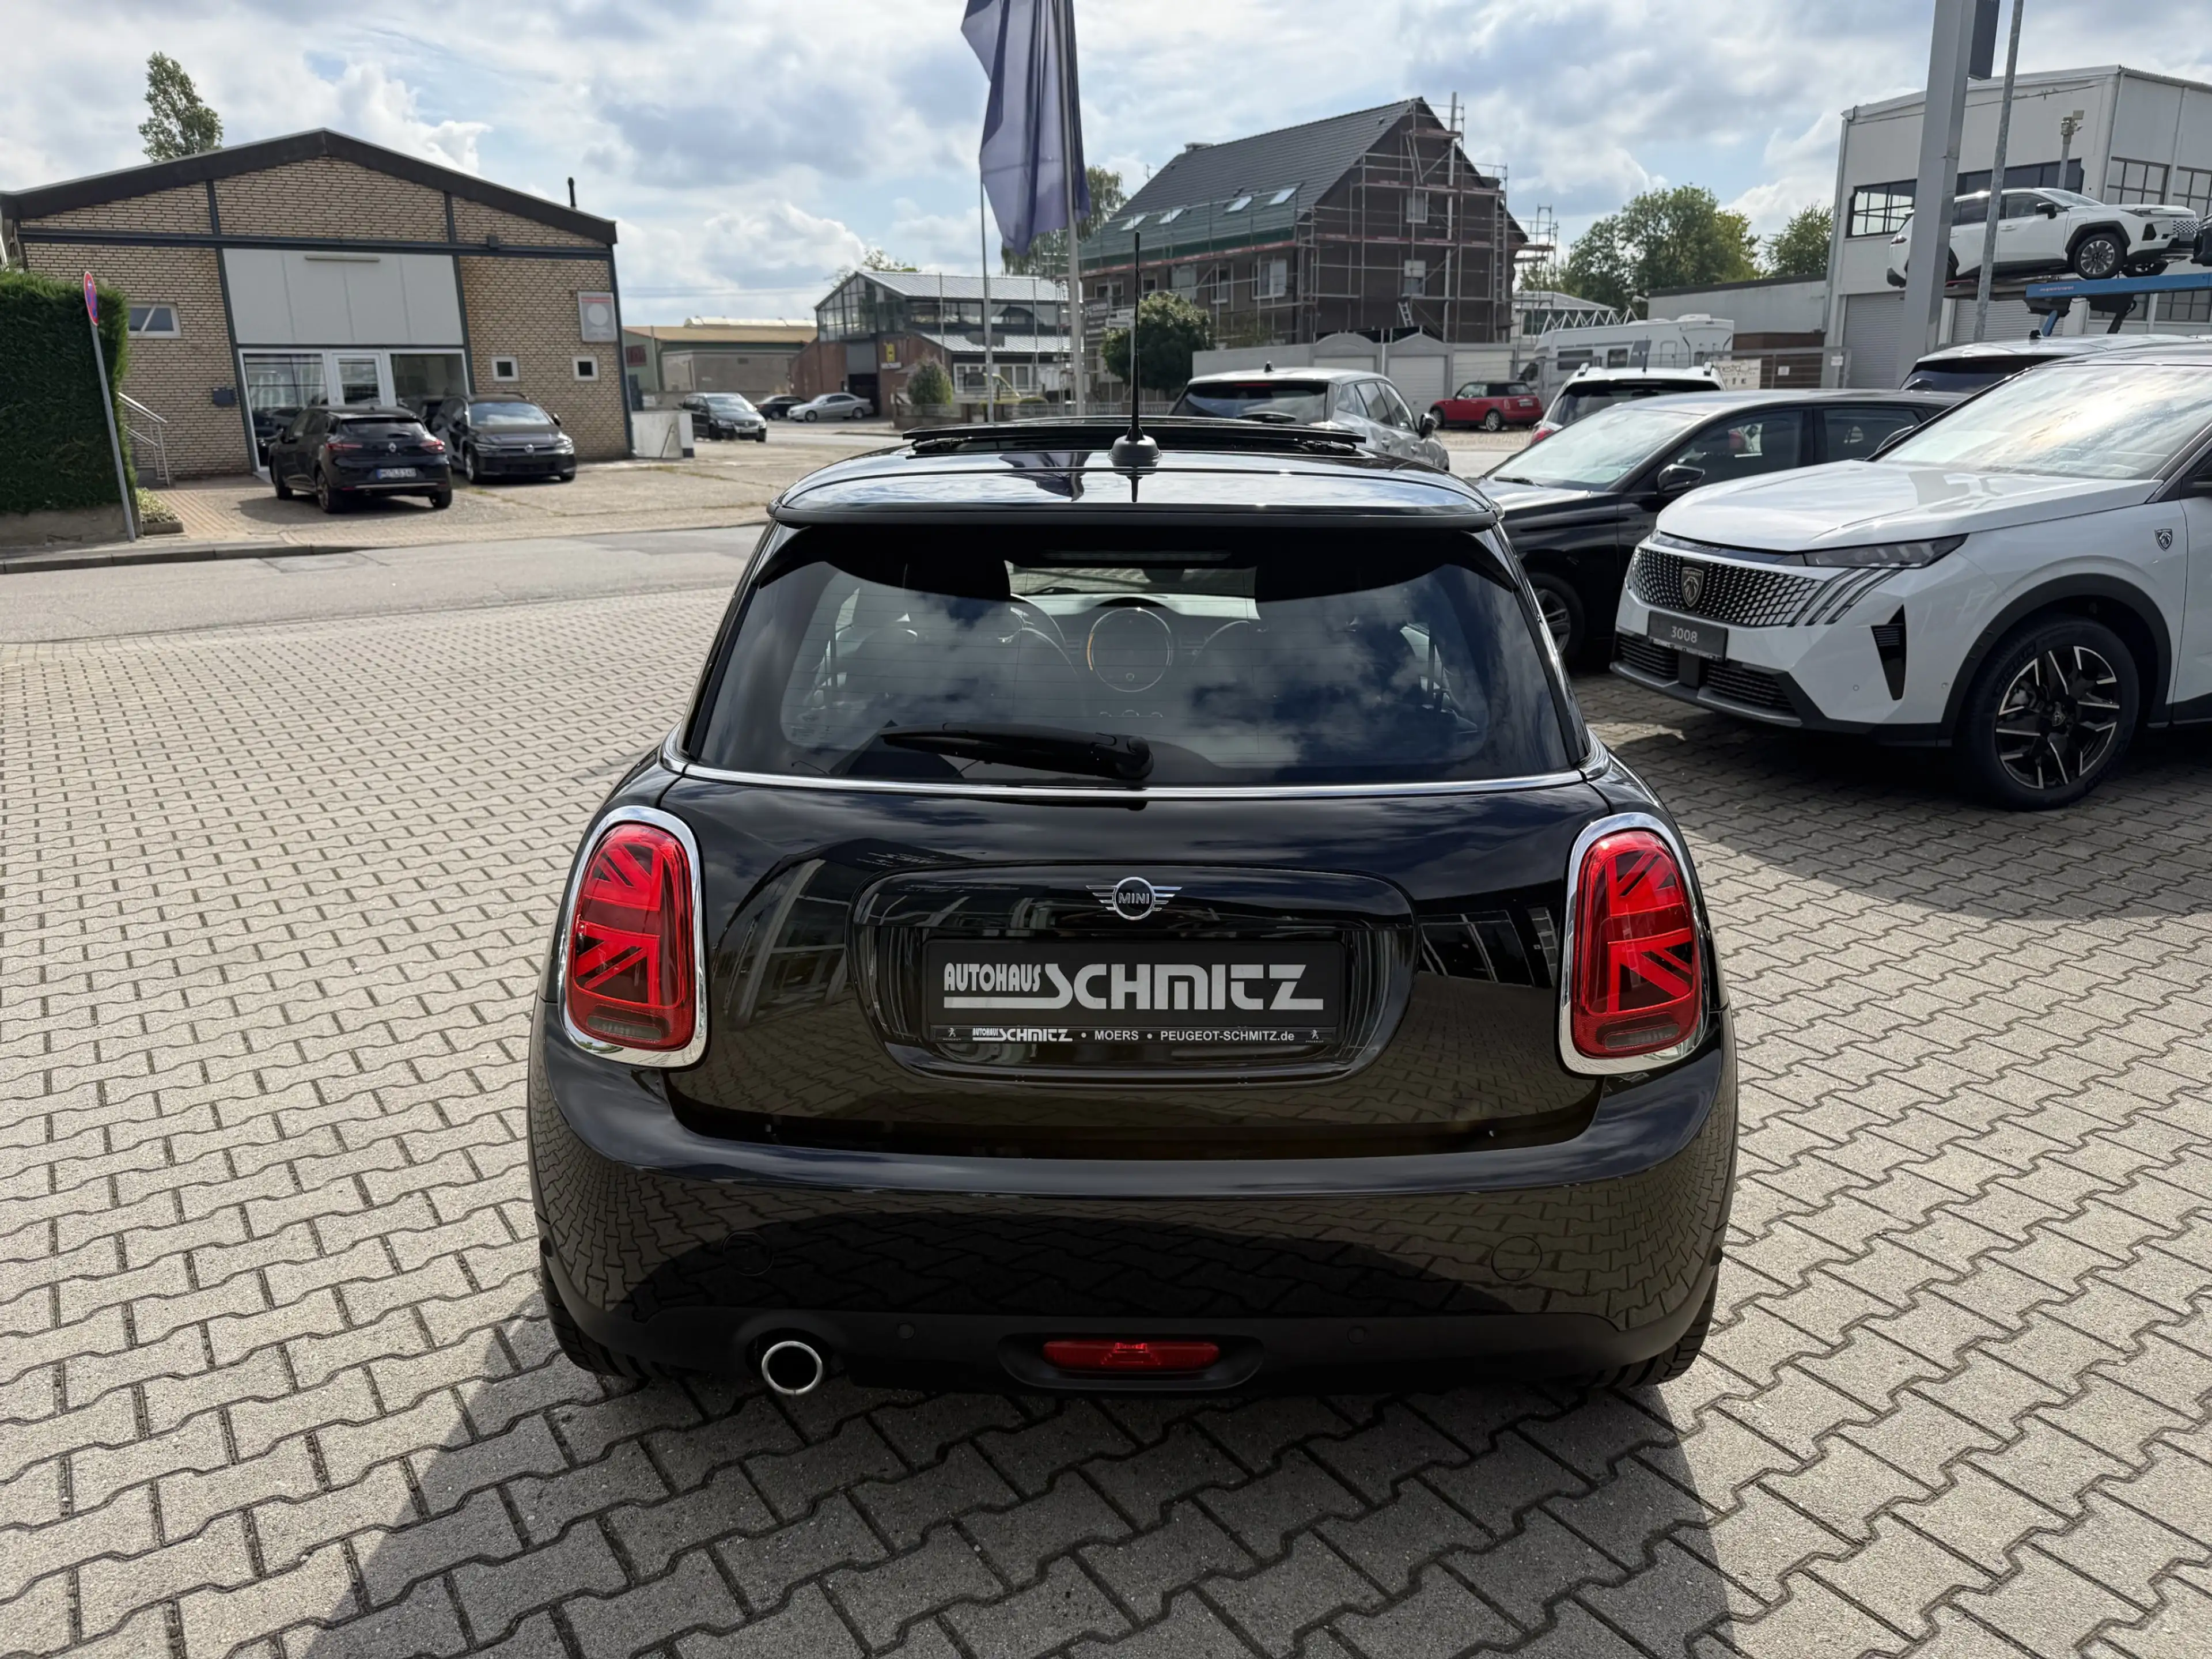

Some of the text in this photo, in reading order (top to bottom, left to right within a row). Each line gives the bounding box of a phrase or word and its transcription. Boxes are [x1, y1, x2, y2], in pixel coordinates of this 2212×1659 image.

[1671, 626, 1698, 643] 3008
[1118, 892, 1150, 904] MINI
[944, 963, 1324, 1010] AUTOHAUS SCHMITZ
[972, 1028, 1295, 1041] AUTOHAUS SCHMITZ MOERS PEUGEOT-SCHMITZ.de
